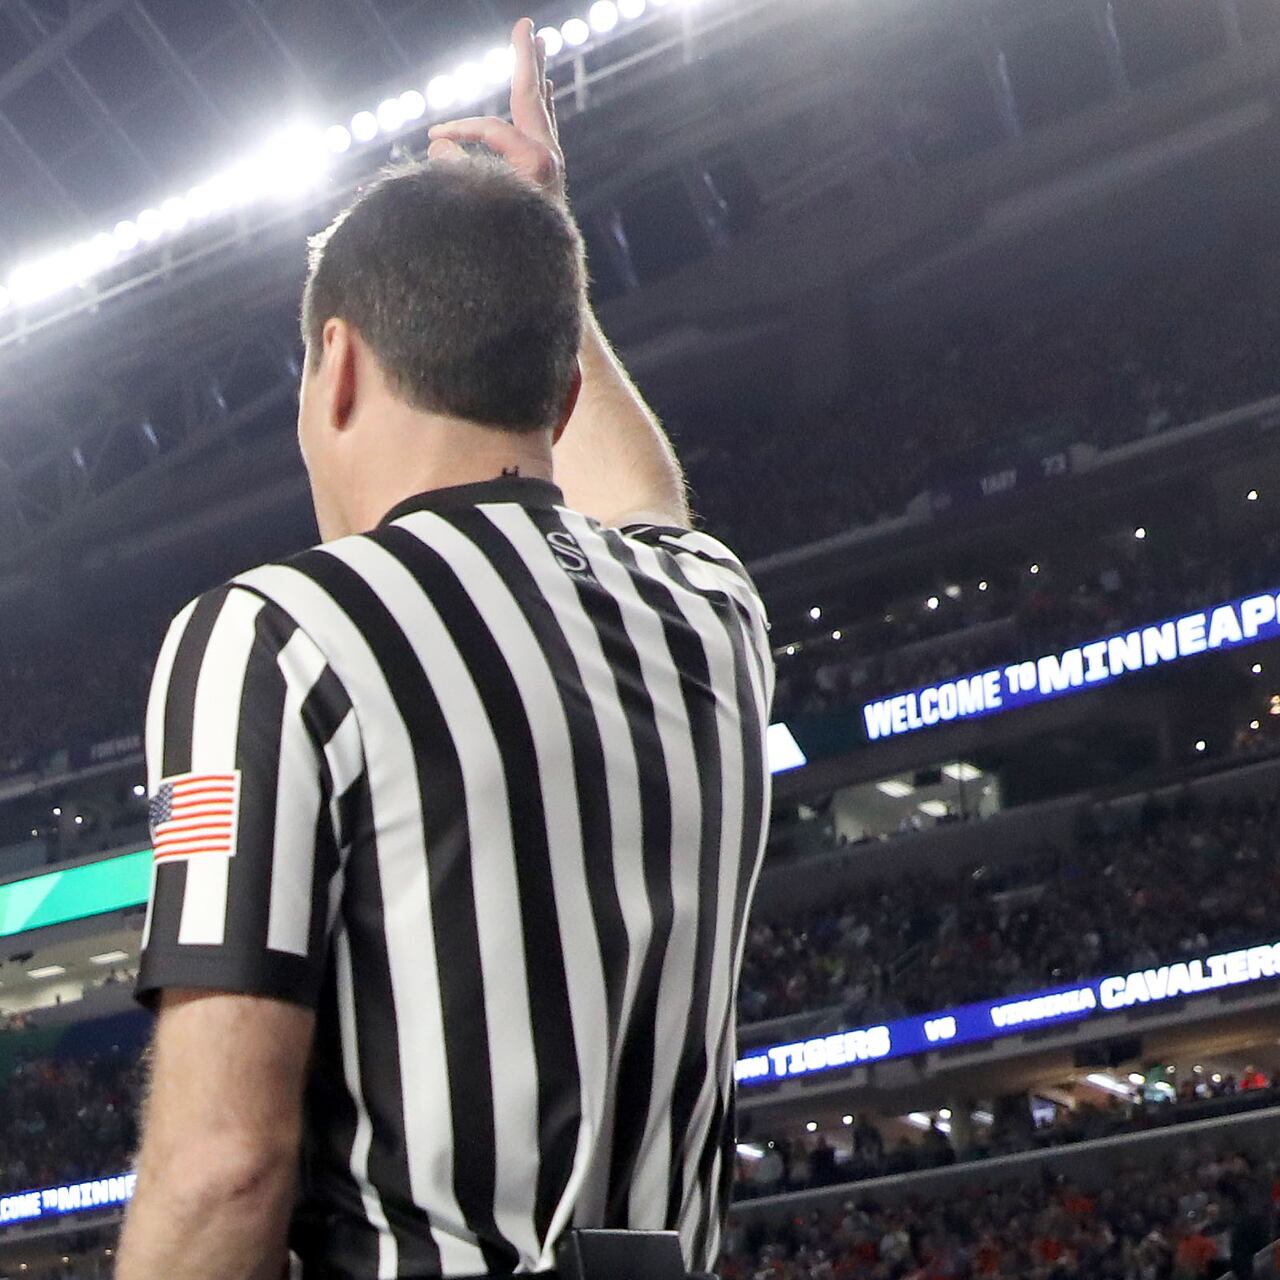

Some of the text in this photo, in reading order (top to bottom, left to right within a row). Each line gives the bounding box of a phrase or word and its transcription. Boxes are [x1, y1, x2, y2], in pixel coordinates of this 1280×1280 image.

[864, 670, 1002, 740] WELCOME
[1004, 661, 1037, 695] TO
[768, 1025, 891, 1077] TIGERS
[924, 1016, 957, 1042] VS
